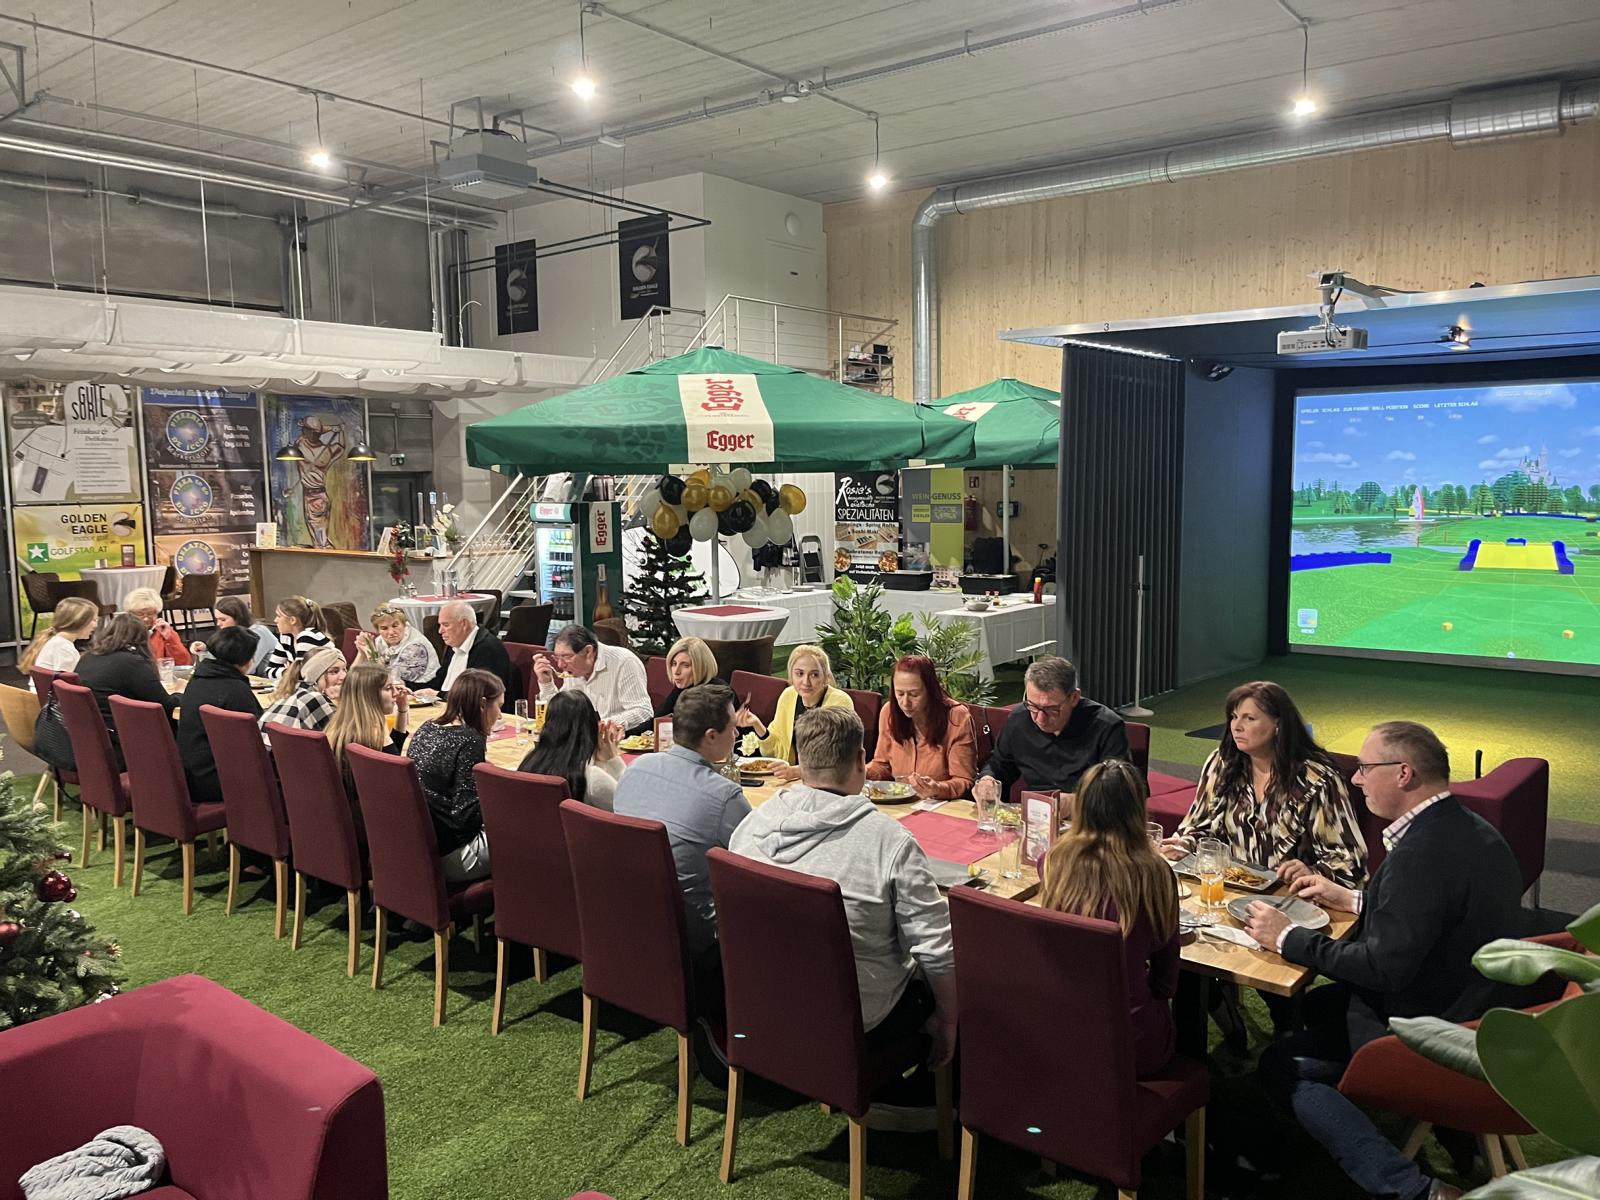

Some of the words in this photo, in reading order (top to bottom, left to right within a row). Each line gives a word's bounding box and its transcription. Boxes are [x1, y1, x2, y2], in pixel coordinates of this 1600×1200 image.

[1103, 322, 1110, 332] 3
[700, 378, 744, 411] Egger
[705, 430, 755, 452] Egger
[931, 492, 962, 501] GENUSS
[61, 513, 107, 524] GOLDEN
[837, 508, 895, 521] SPEZIALITÄTEN
[71, 524, 109, 535] EAGLE
[595, 509, 608, 546] Egger
